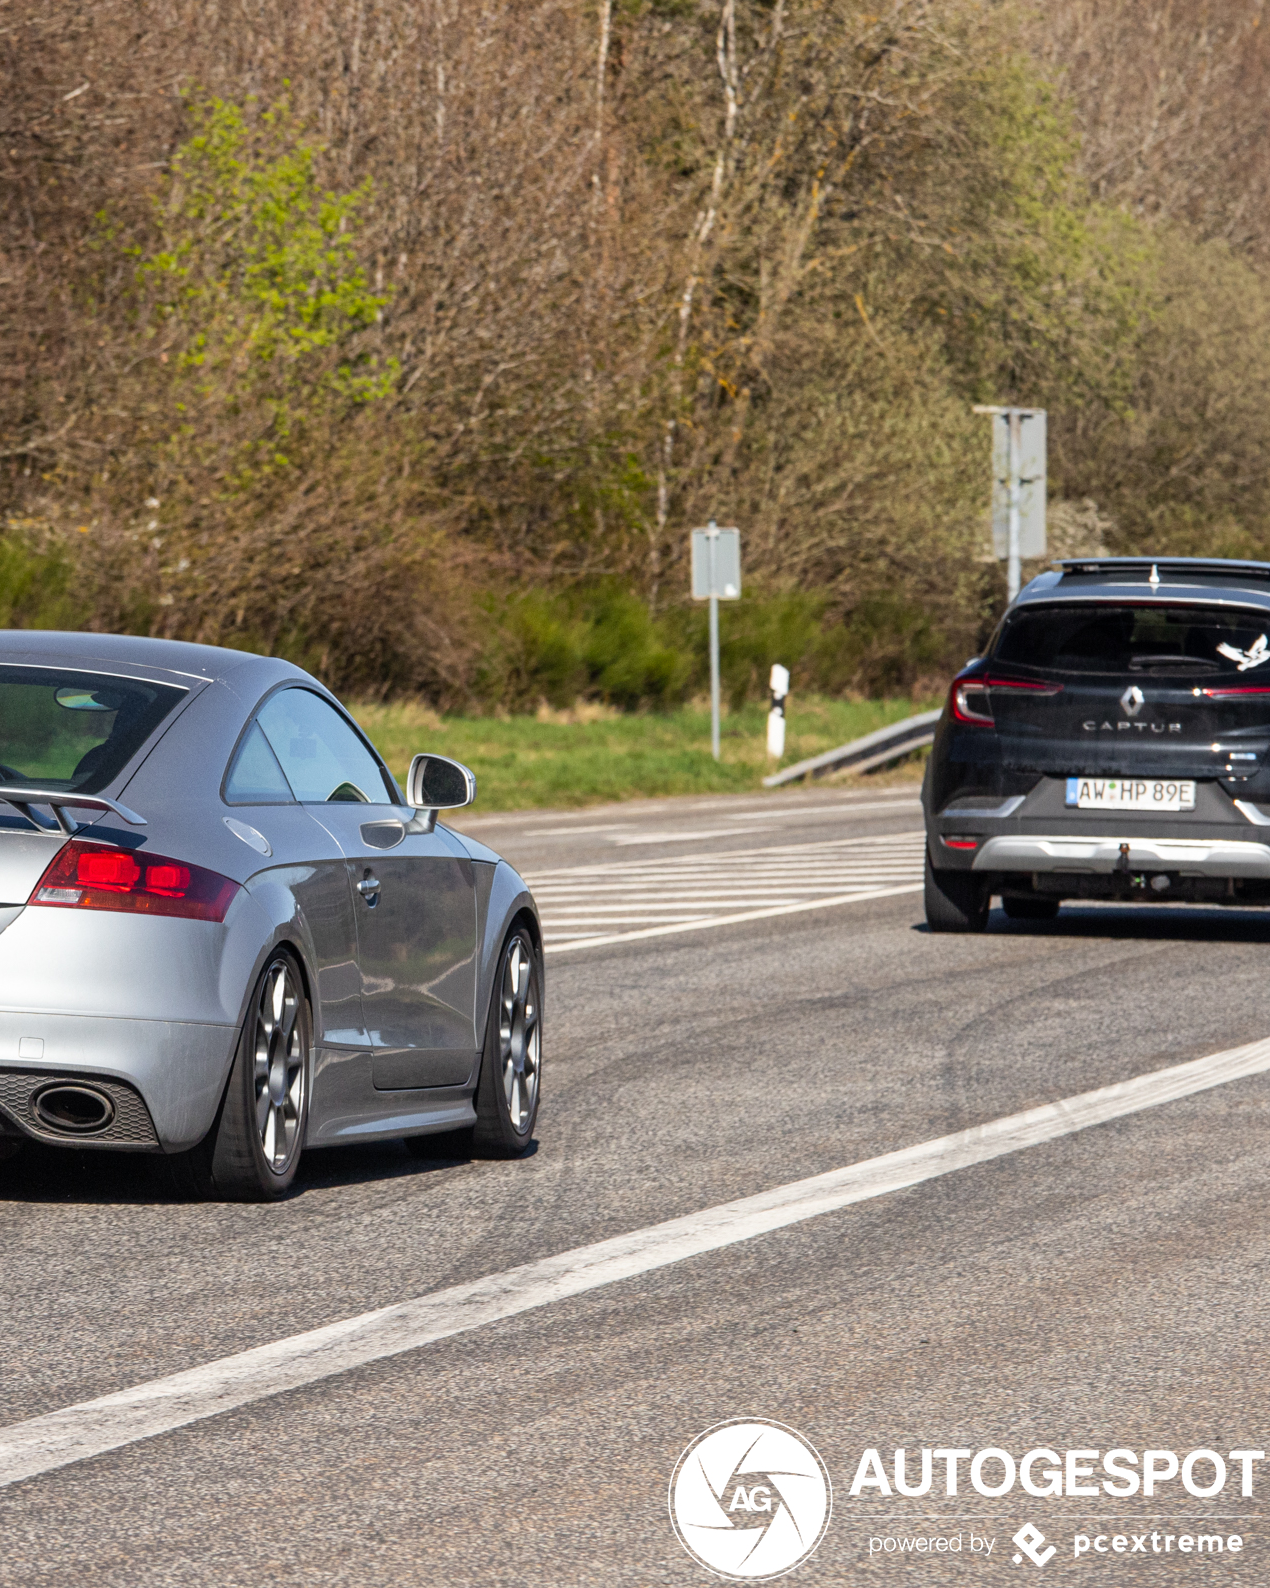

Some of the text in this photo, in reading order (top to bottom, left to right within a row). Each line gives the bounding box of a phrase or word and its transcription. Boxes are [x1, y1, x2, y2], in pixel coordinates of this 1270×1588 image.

[1082, 720, 1182, 733] CAPTUR
[1080, 781, 1105, 801] AW
[1120, 782, 1147, 801] HP
[1153, 783, 1191, 802] 89E
